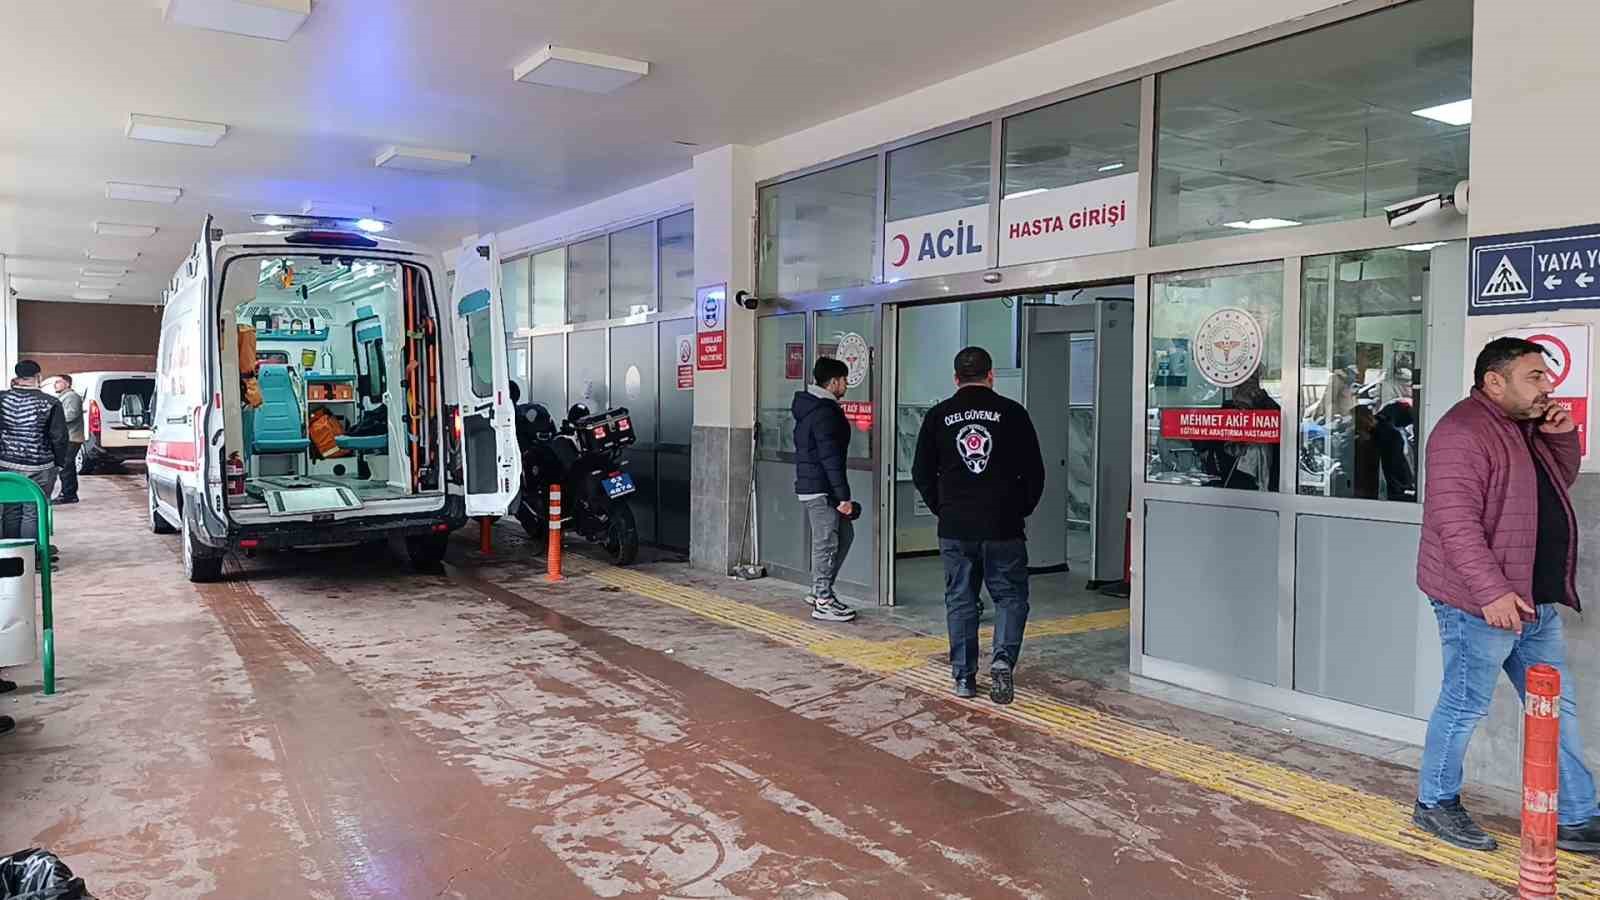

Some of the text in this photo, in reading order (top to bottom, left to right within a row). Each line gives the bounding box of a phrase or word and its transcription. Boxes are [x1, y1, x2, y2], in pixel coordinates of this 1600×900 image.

[1009, 199, 1126, 239] HASTA GİRİŞİ
[918, 219, 982, 261] ACİL
[1538, 249, 1600, 272] YAYA Y
[944, 411, 965, 426] ÖZEL
[1180, 412, 1279, 428] MEHMET AKİF İNAN
[1200, 428, 1208, 436] VE
[1208, 428, 1243, 437] ARAŞTIRMA
[1244, 429, 1279, 438] HASTANESİ
